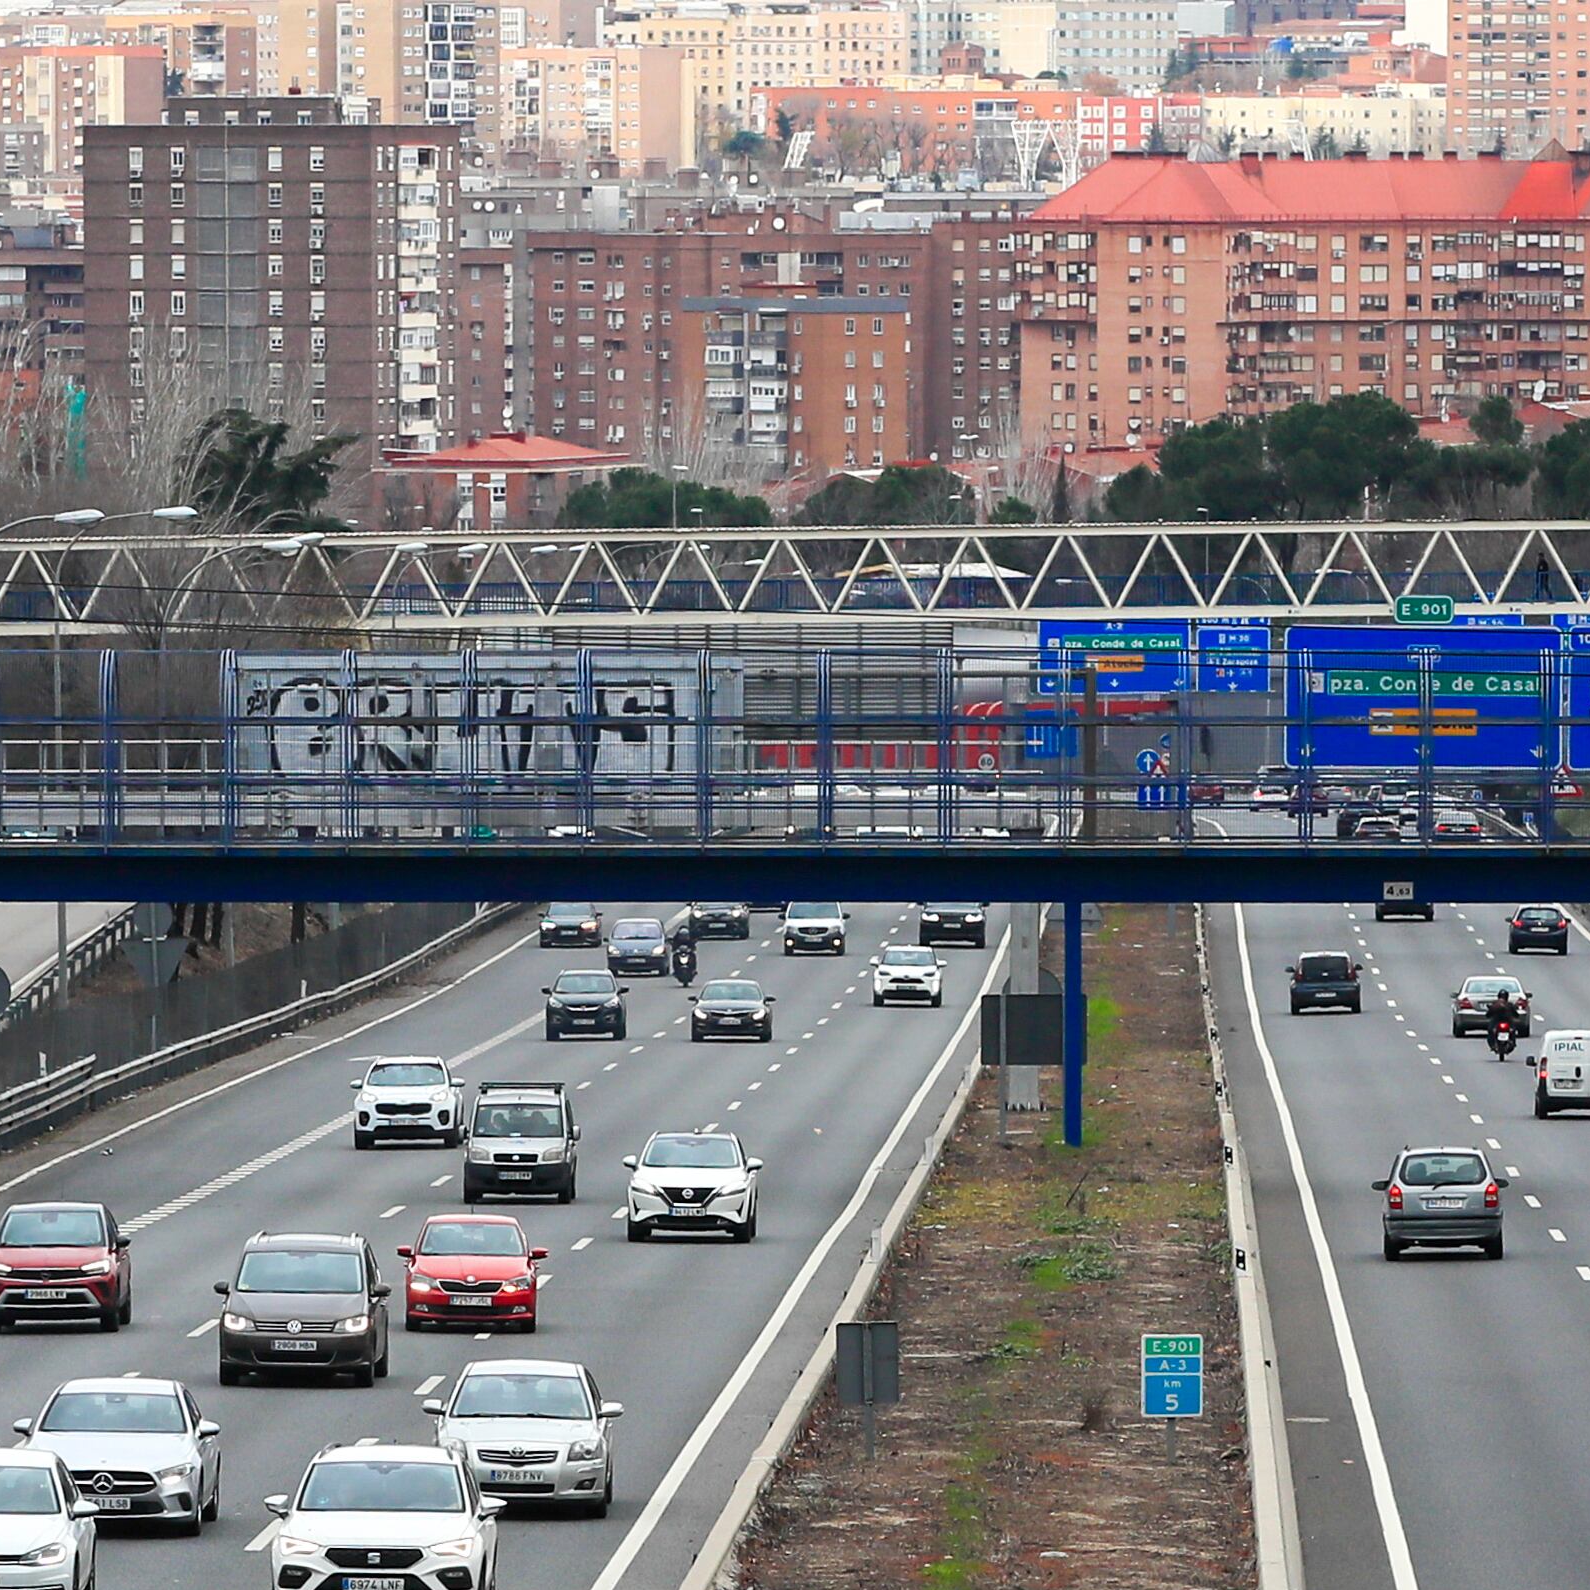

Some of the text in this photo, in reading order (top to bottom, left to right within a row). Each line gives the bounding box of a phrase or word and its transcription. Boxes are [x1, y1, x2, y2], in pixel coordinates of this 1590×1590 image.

[1401, 603, 1447, 616] E-901
[1091, 638, 1125, 649] Conde
[1130, 638, 1144, 648] de
[1149, 637, 1181, 648] Casal
[1330, 677, 1370, 696] pza.
[1379, 676, 1441, 692] Cone
[1452, 676, 1474, 692] de
[1554, 1042, 1585, 1052] IPIAL
[1153, 1340, 1194, 1352] E-901
[1159, 1360, 1187, 1371] A-3
[1163, 1379, 1182, 1388] km
[1165, 1393, 1179, 1411] 5
